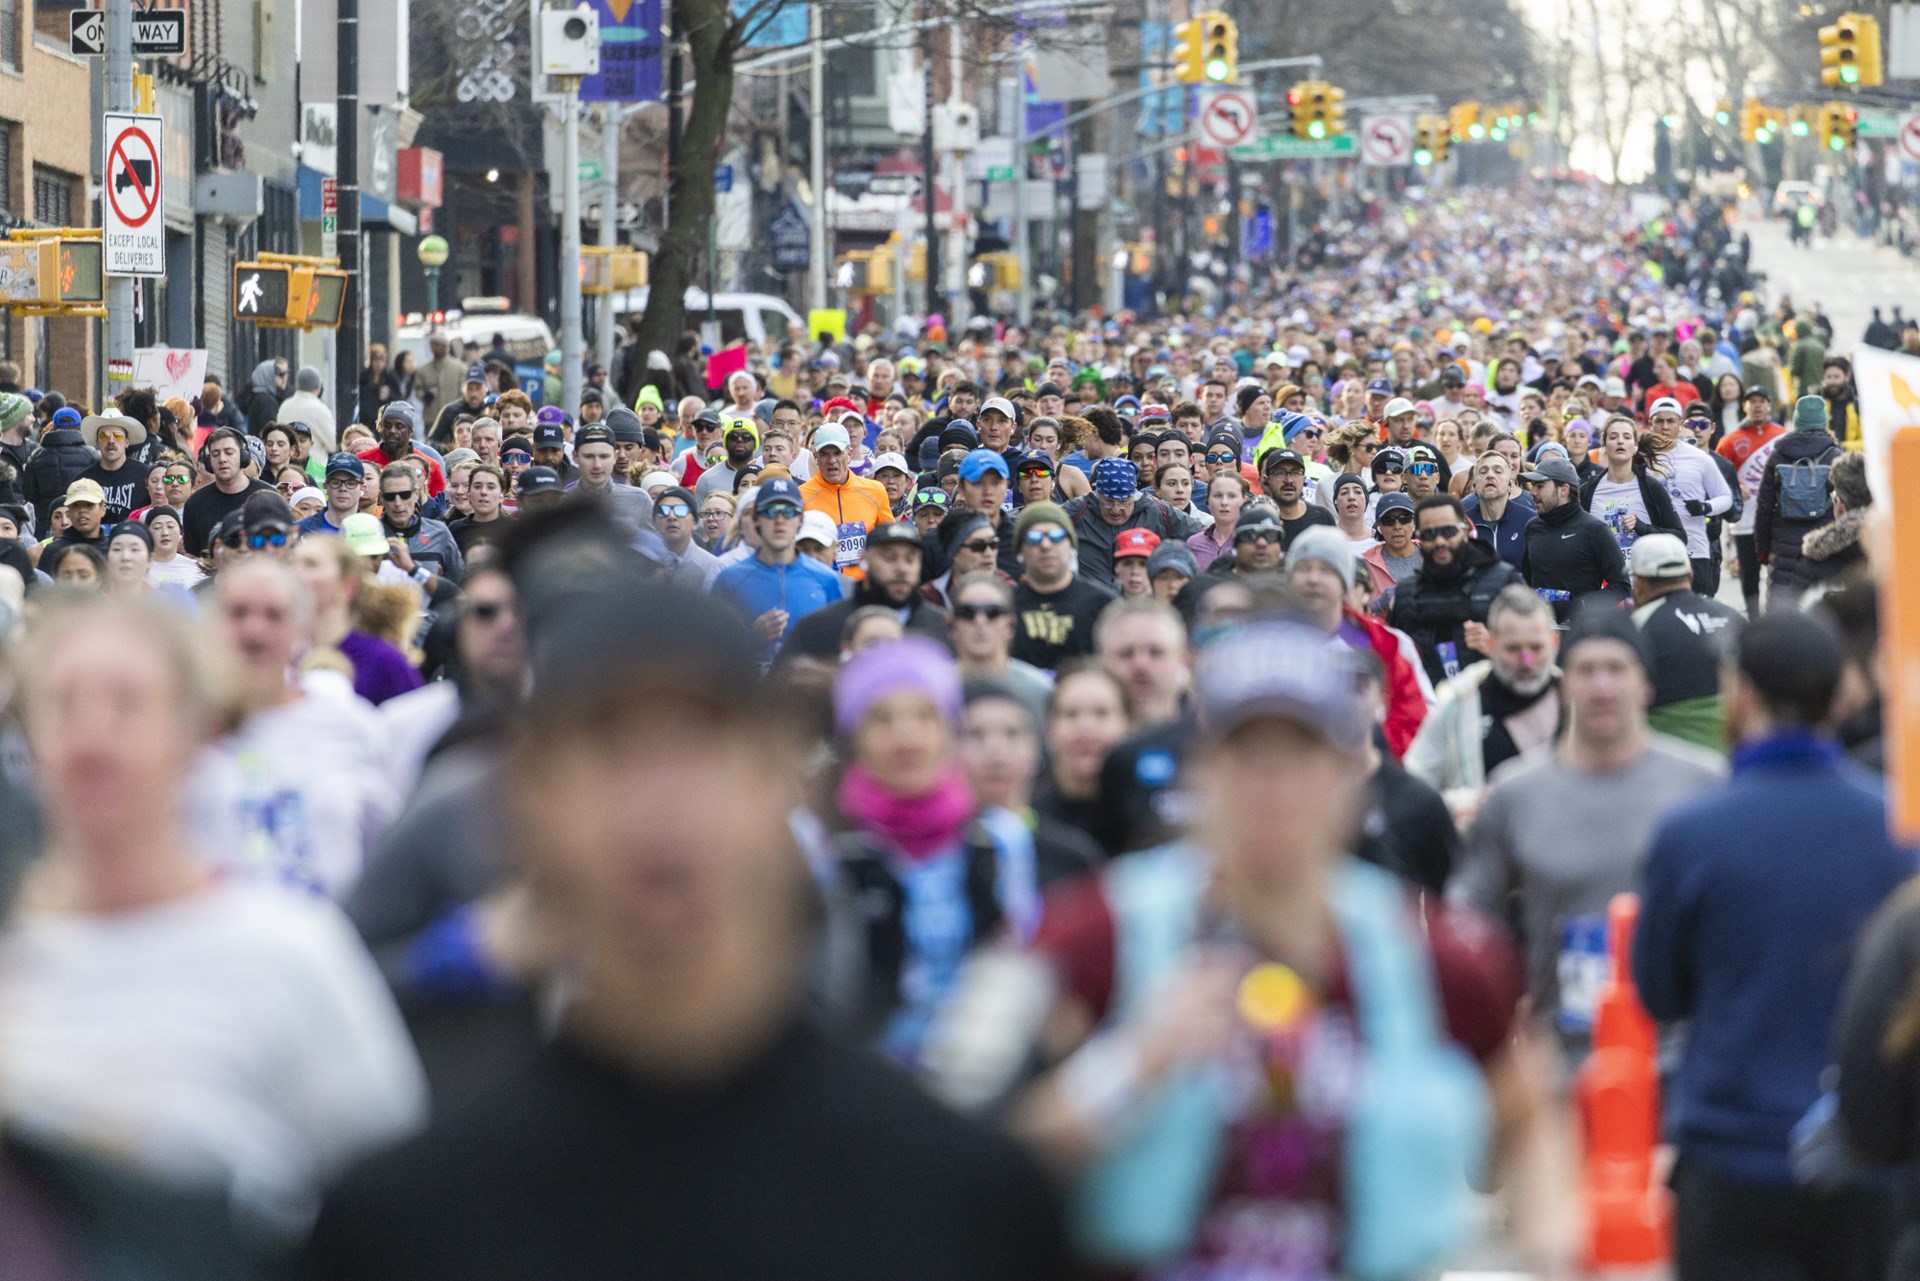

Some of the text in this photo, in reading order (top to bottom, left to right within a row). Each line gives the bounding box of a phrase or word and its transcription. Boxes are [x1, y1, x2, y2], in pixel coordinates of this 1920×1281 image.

[86, 24, 174, 41] ON WAY
[109, 234, 159, 249] EXCEPT LOCAL
[114, 252, 154, 266] DELIVERIES
[840, 537, 866, 552] 8090
